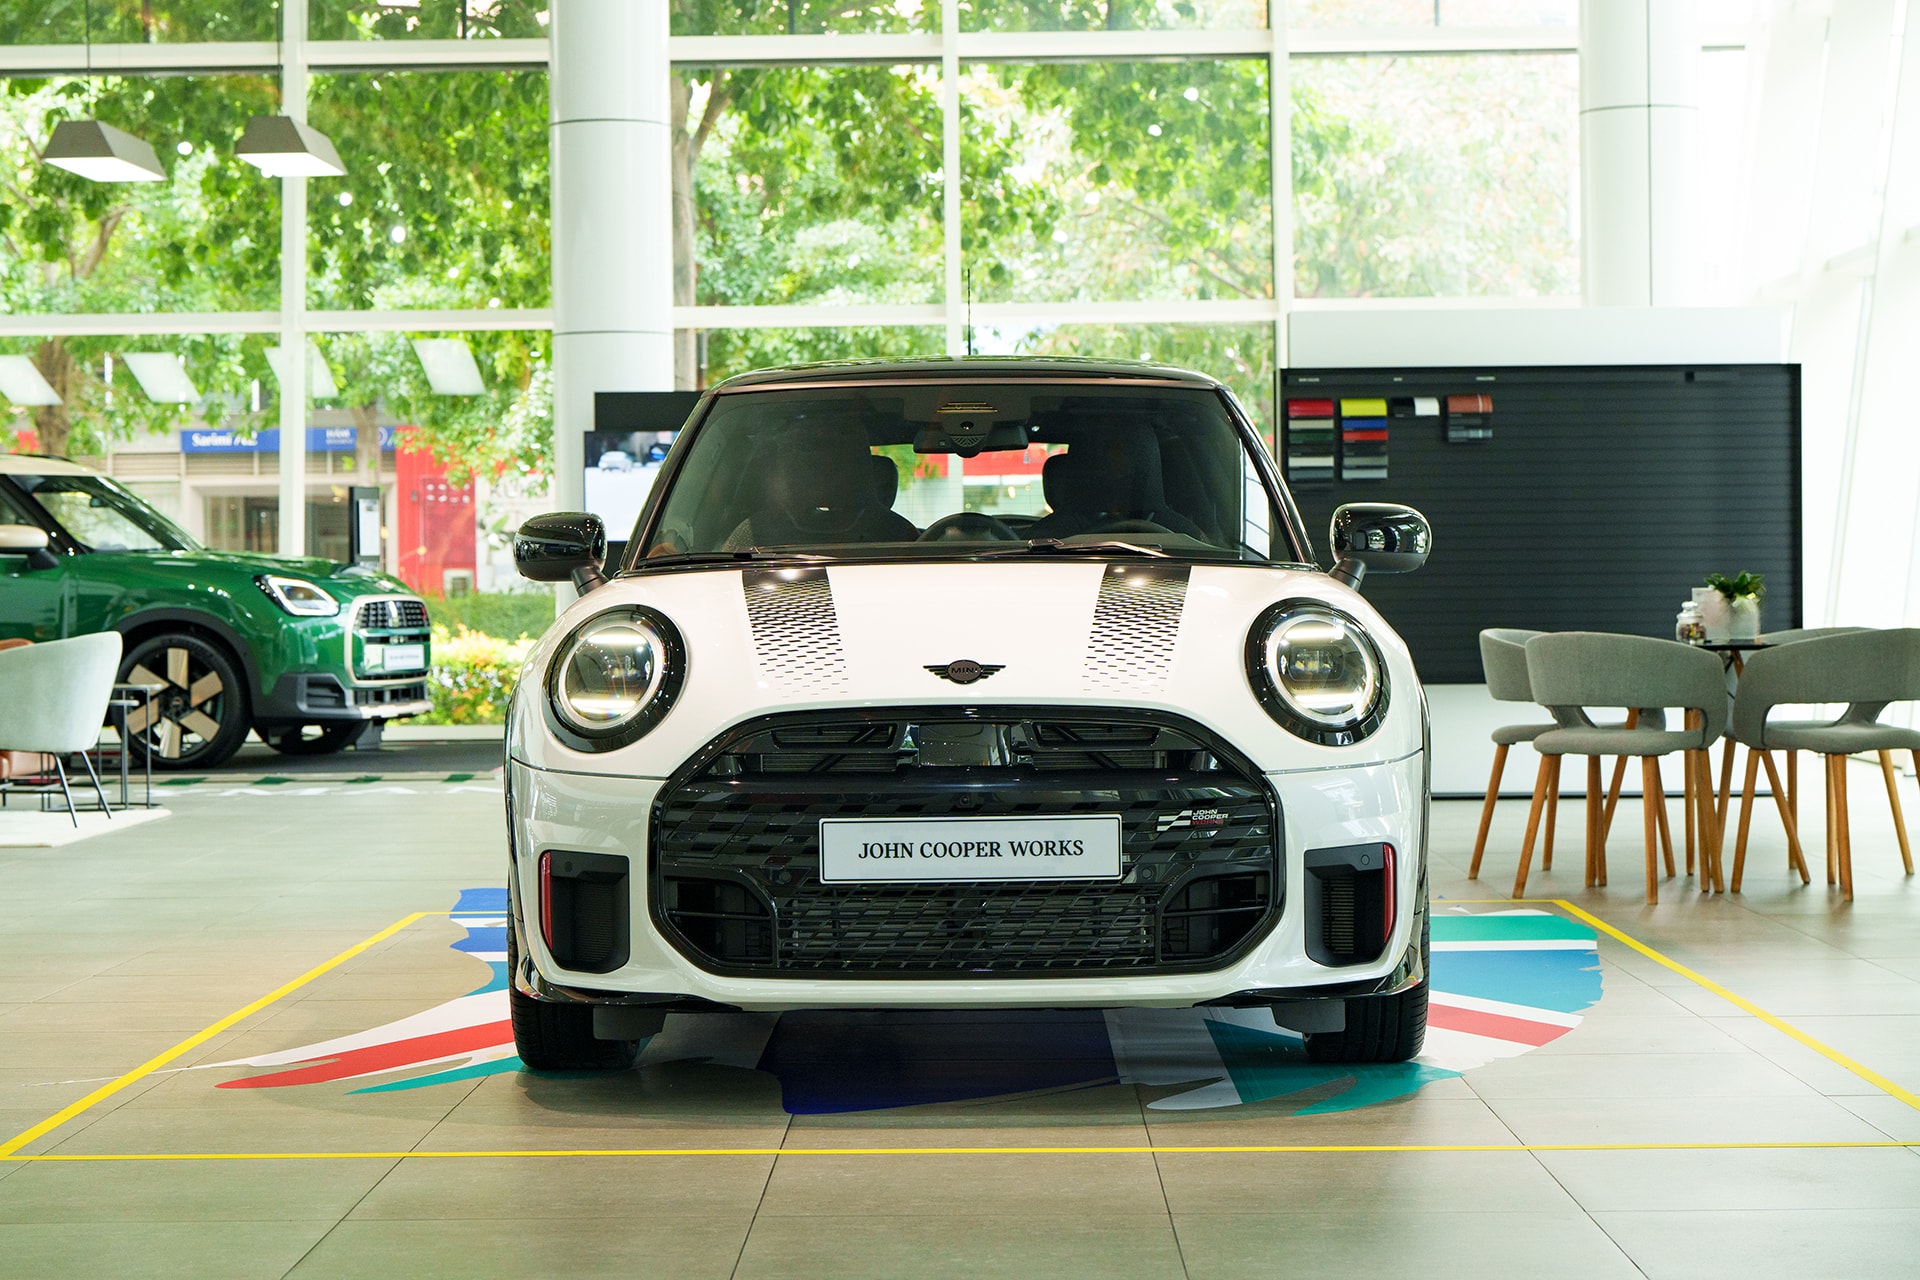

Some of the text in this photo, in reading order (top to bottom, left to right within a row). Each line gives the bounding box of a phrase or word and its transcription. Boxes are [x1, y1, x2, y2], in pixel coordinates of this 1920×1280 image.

[1192, 813, 1229, 821] COOPER
[858, 839, 1084, 859] JOHN COOPER WORKS
